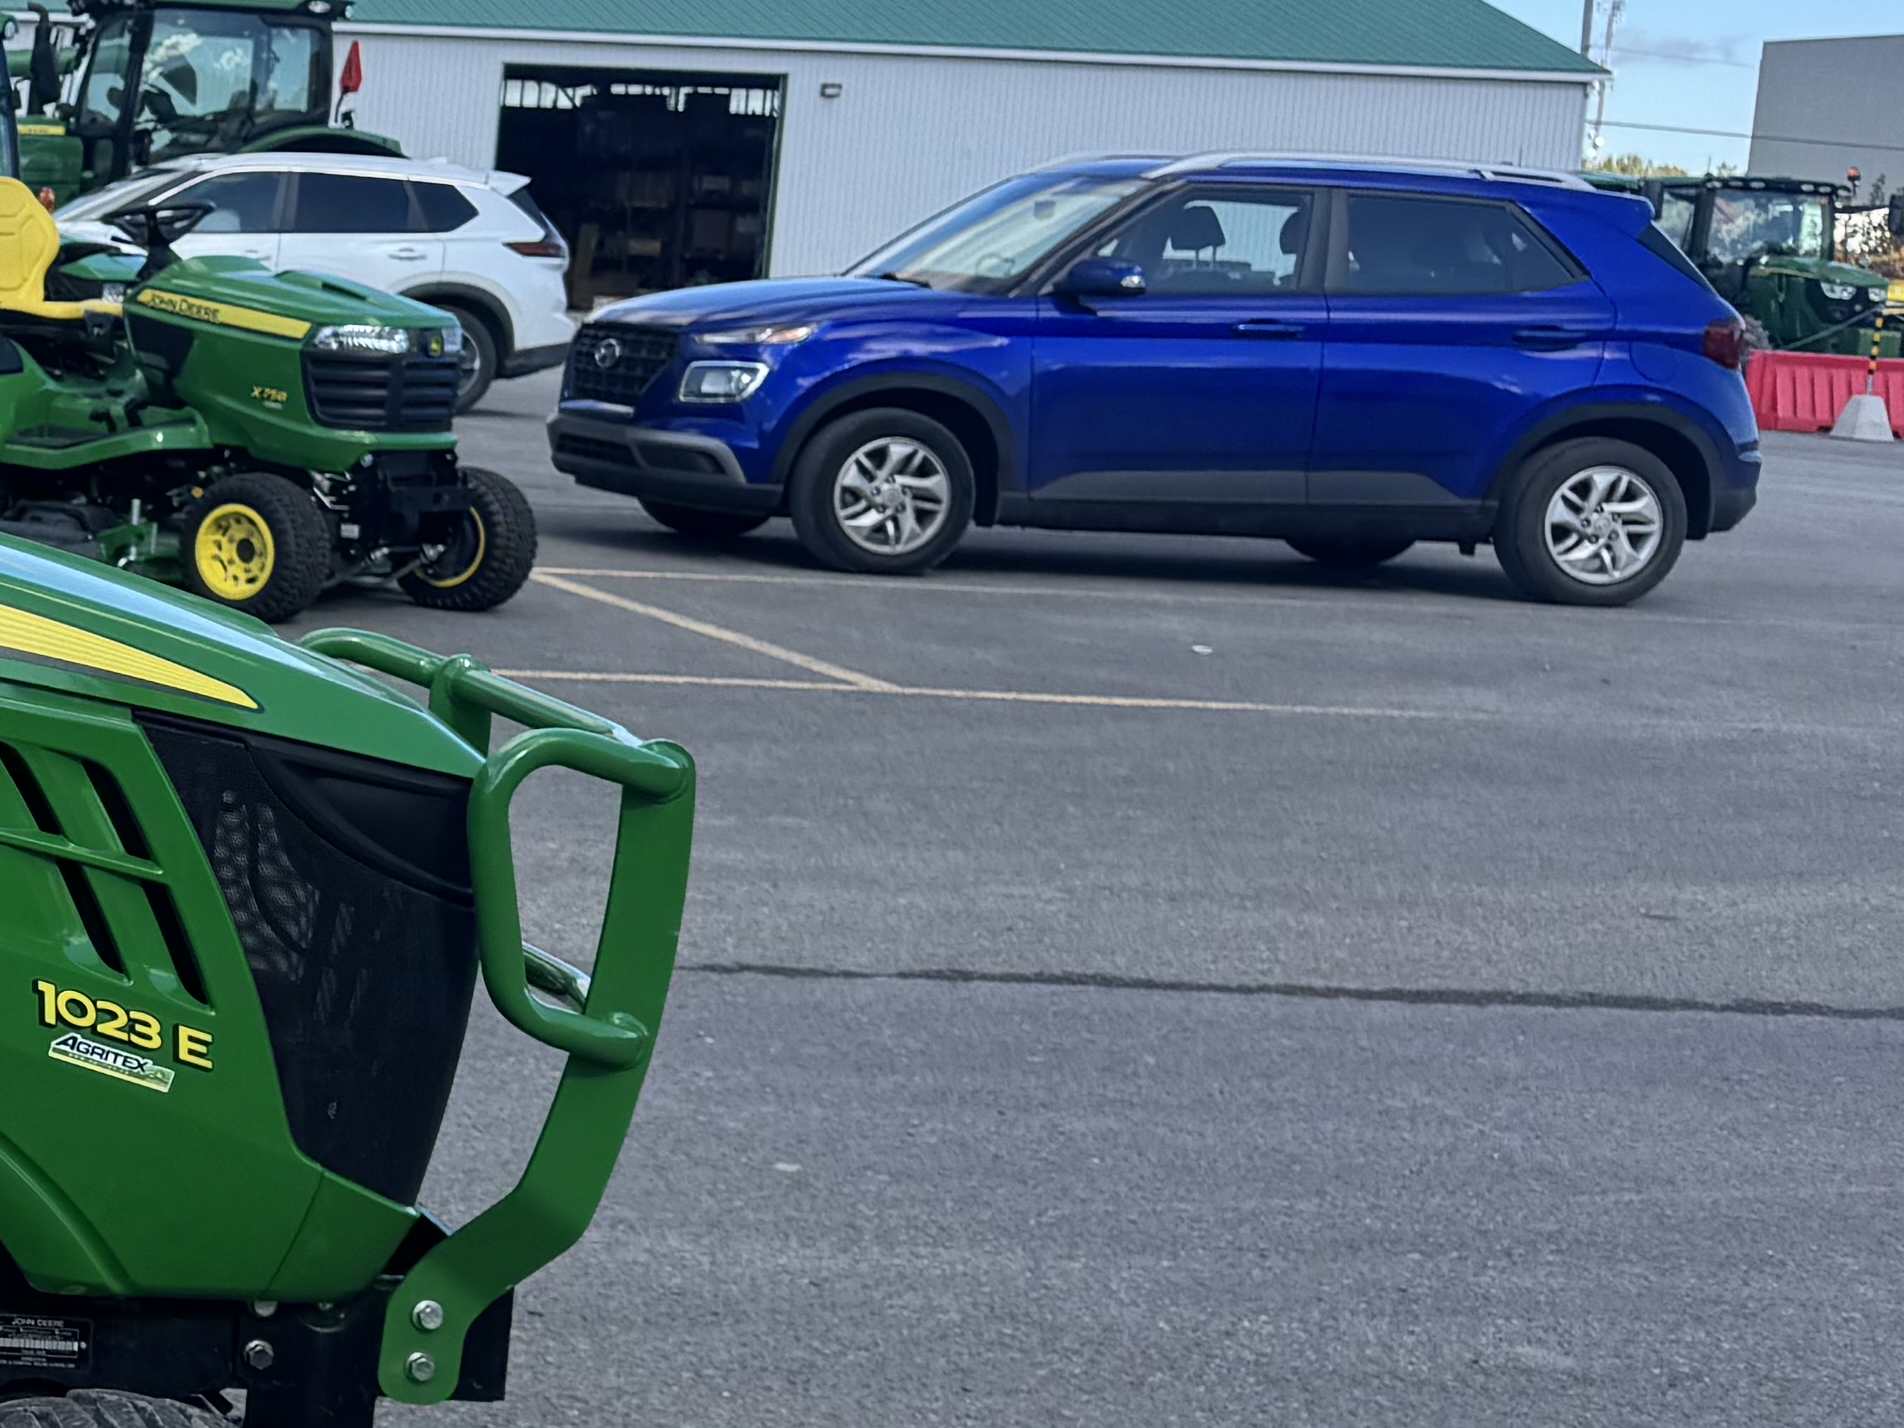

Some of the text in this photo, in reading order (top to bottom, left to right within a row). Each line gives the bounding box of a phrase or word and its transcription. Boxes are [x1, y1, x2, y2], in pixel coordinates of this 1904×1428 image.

[34, 979, 214, 1070] 1023 E
[54, 1035, 151, 1073] AGRITEX
